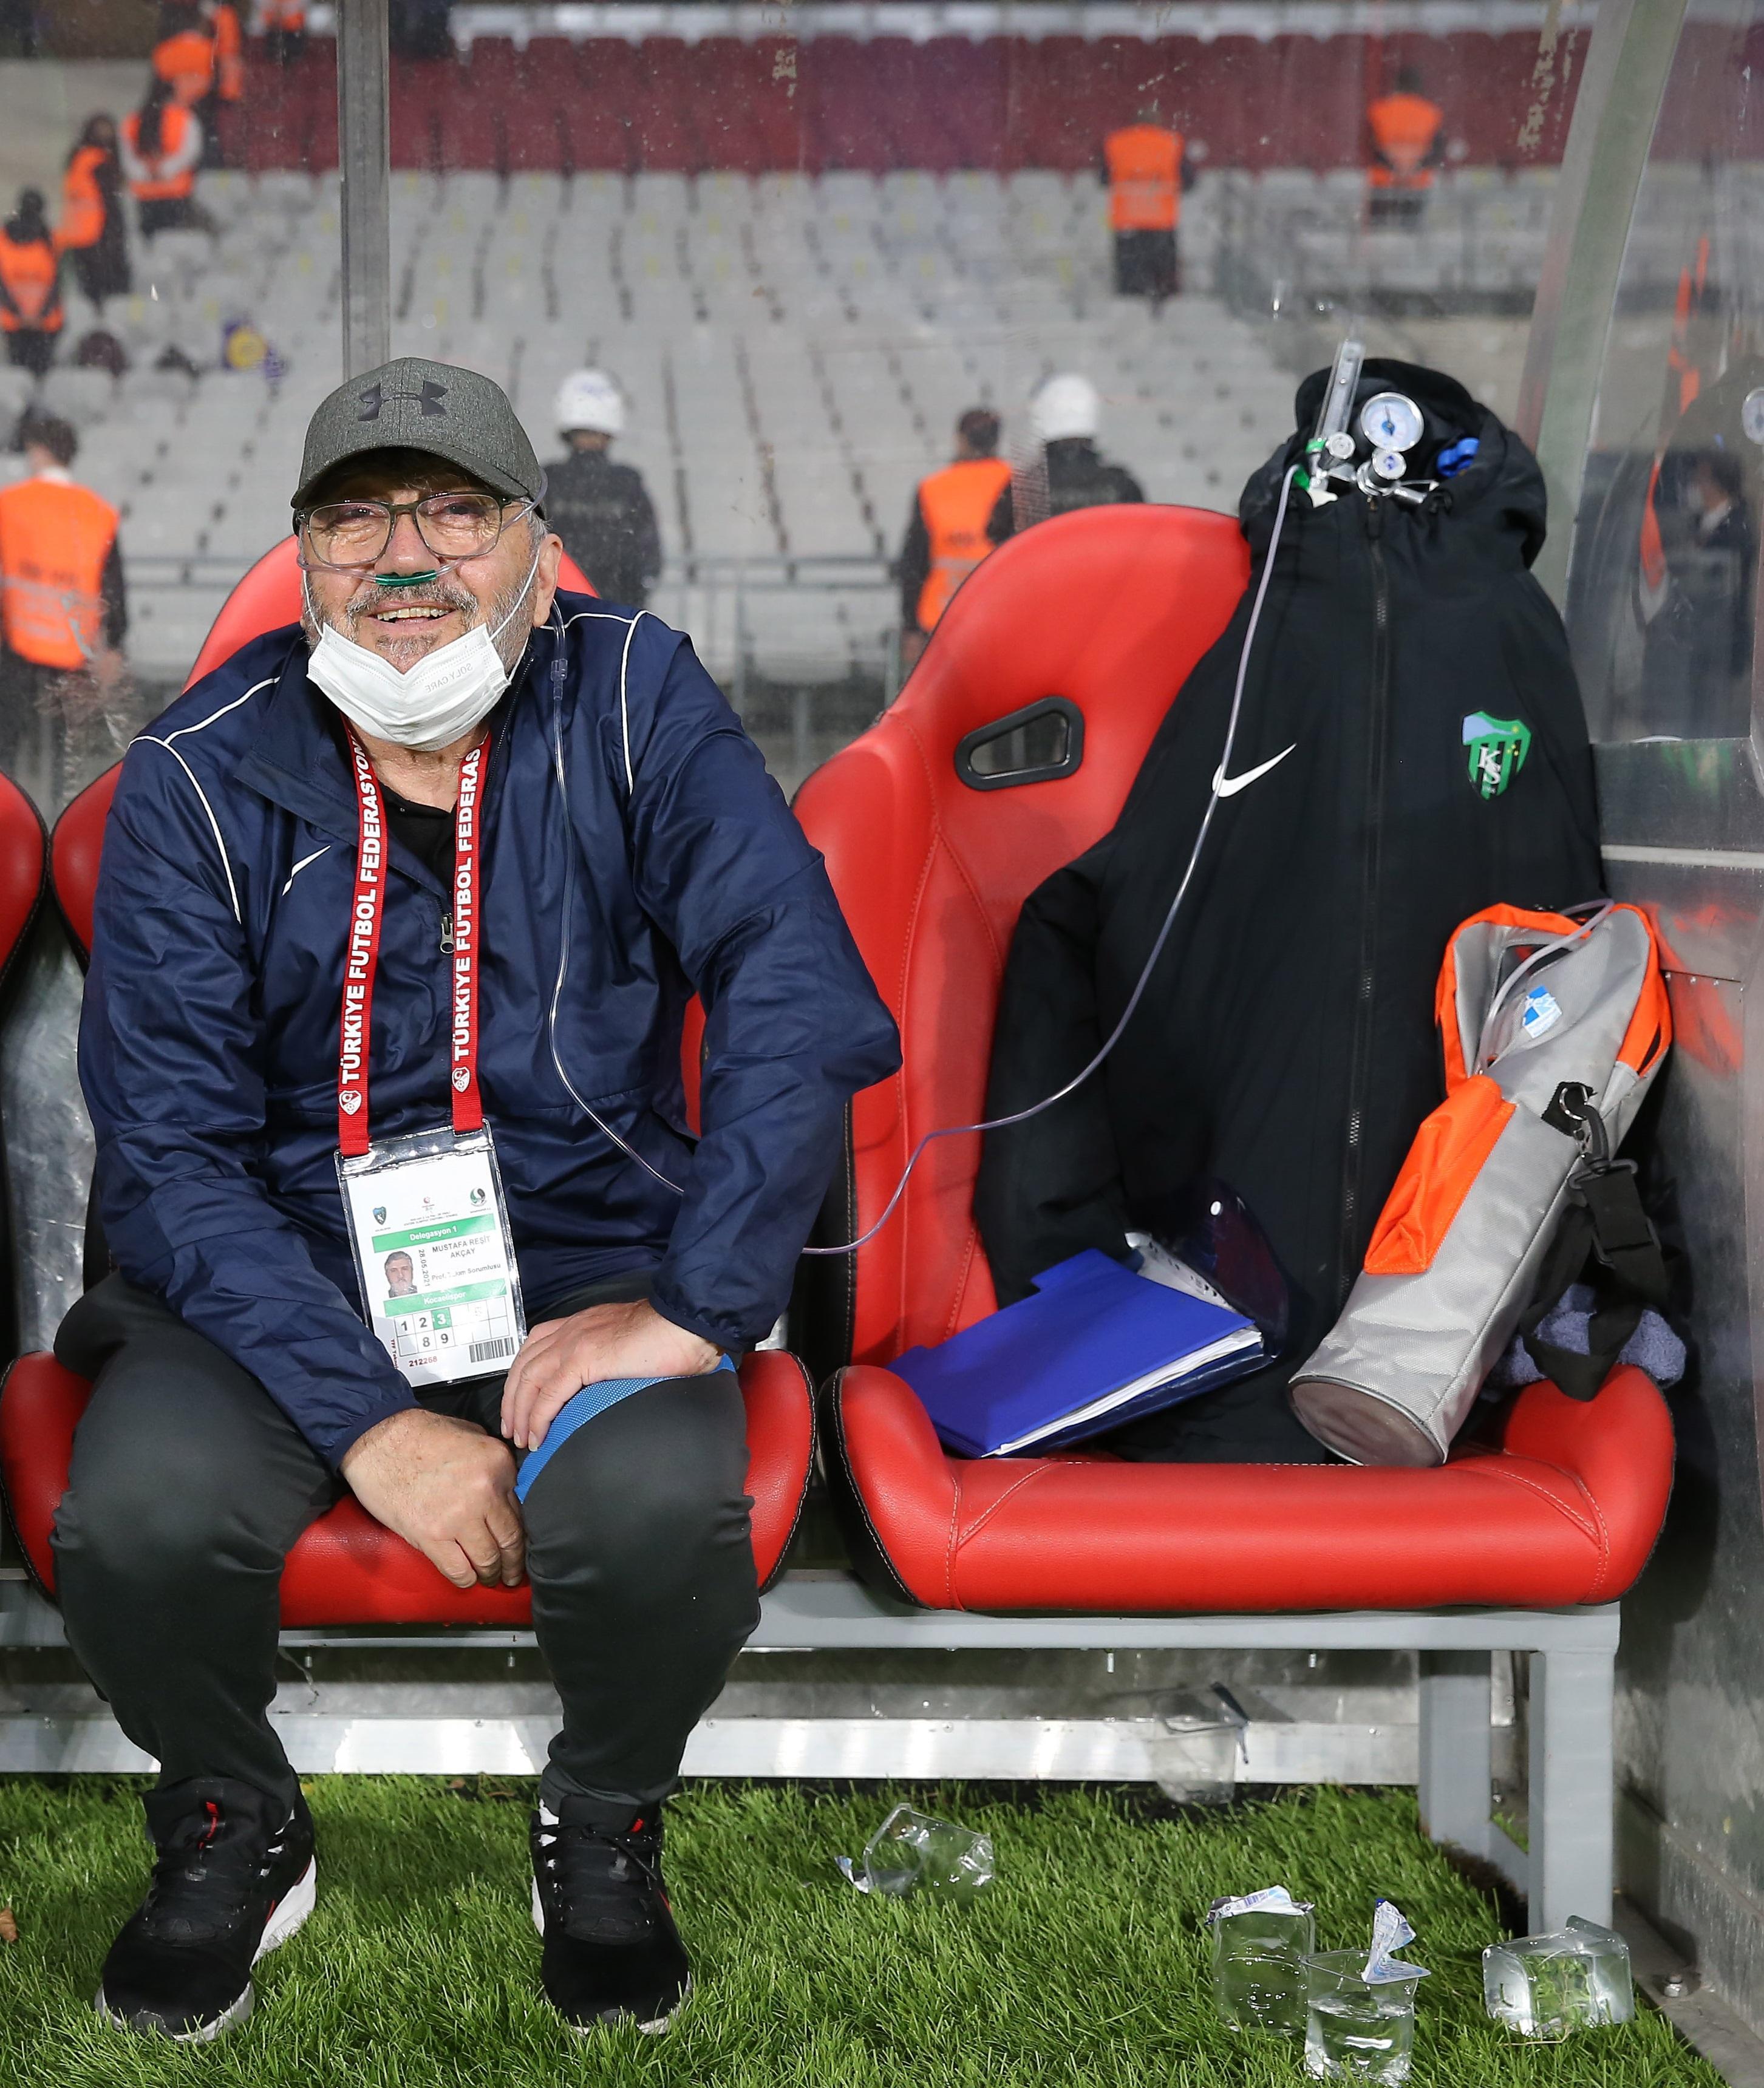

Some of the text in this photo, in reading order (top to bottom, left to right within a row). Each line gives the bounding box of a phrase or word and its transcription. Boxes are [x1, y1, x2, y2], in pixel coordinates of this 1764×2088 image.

[451, 732, 488, 1061] TÜRKİYE FUTBOL FEDERAS
[340, 729, 380, 1084] TÜRKİYE FUTBOL FEDERASYON
[409, 1227, 452, 1241] Delegasyon
[432, 1235, 491, 1253] MUSTAFA REŞİT
[451, 1248, 475, 1258] AKÇAY
[468, 1263, 501, 1274] Sorumlusu
[401, 1321, 408, 1331] 1
[419, 1318, 427, 1328] 2
[437, 1313, 446, 1325] 3
[423, 1333, 449, 1347] 8 9
